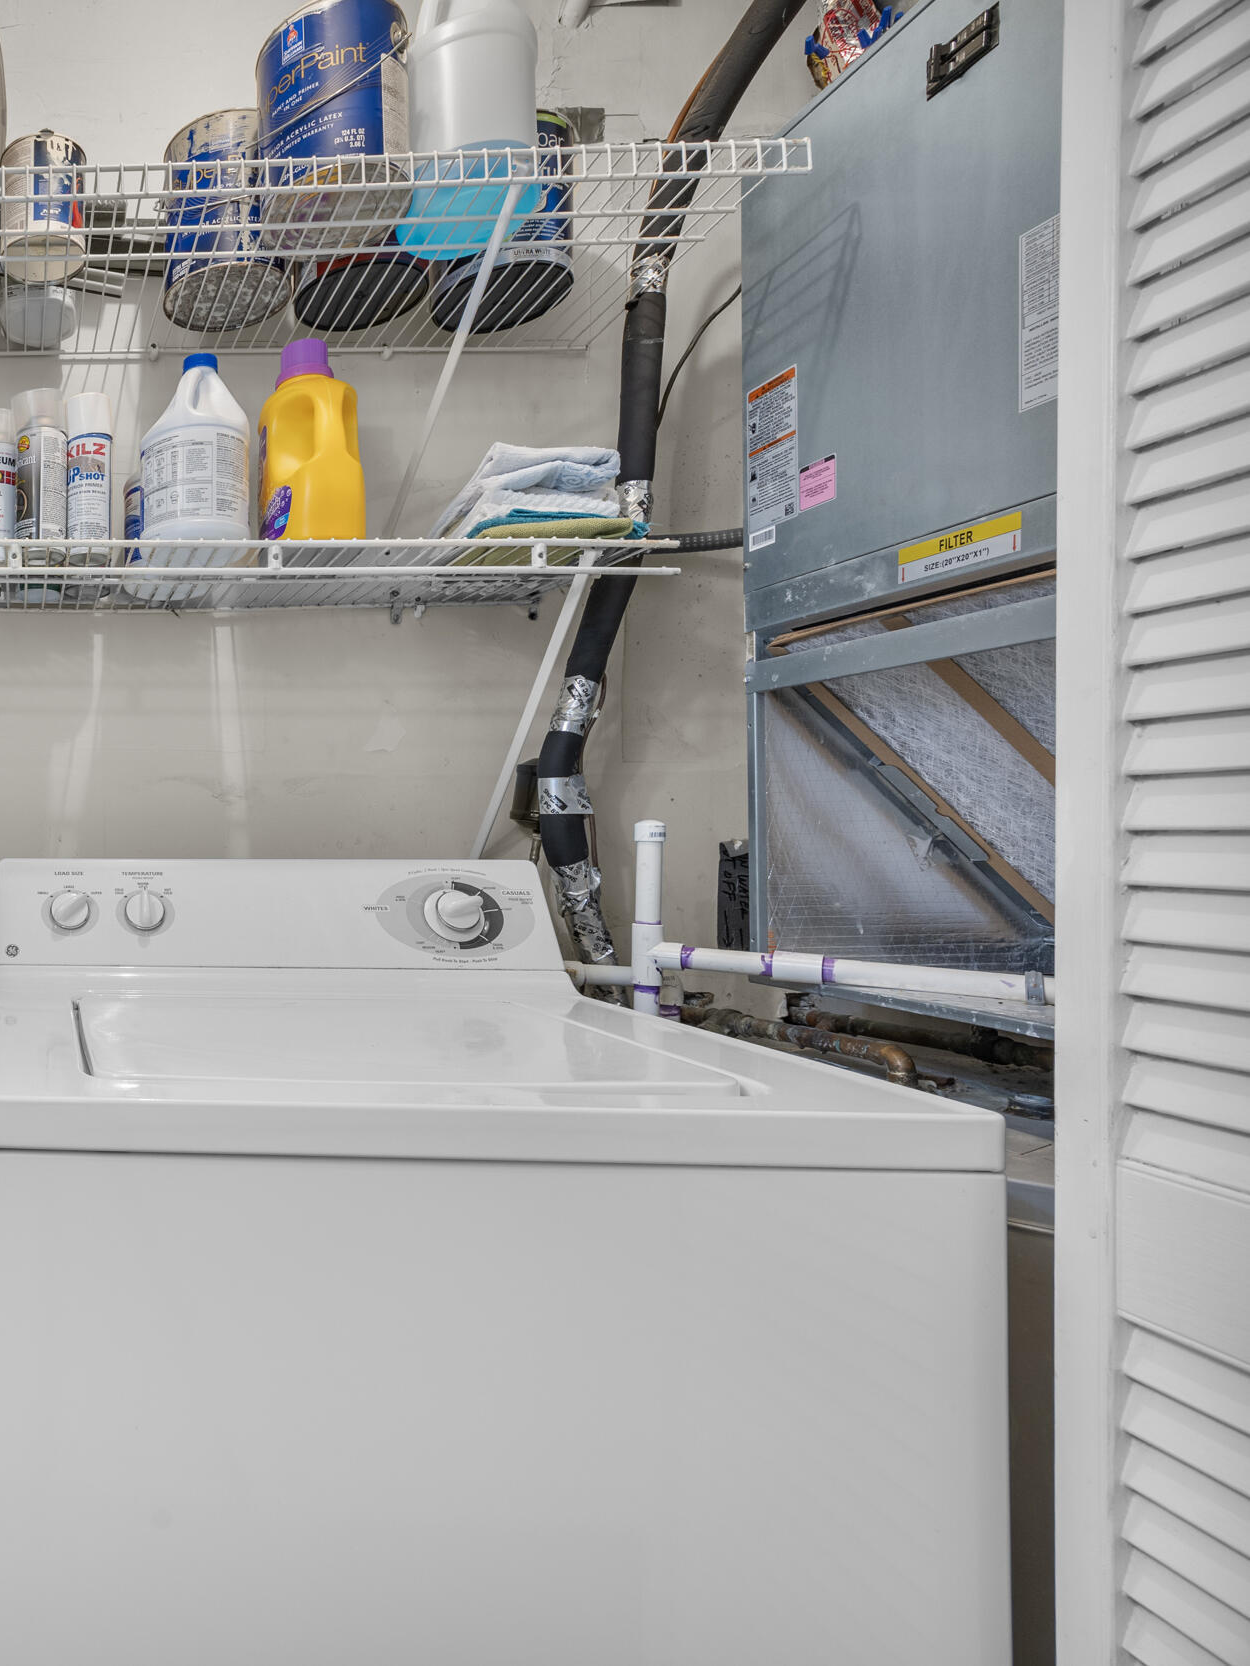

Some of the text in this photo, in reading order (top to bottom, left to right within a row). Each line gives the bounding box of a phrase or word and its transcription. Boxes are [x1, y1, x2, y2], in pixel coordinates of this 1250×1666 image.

[285, 93, 297, 105] AND
[298, 82, 319, 96] PRIMER
[291, 95, 303, 107] ONE
[286, 119, 316, 142] ACRYLIC
[319, 112, 343, 123] LATEX
[302, 123, 334, 139] WARRANTY
[67, 442, 106, 459] KILZ
[938, 530, 974, 552] FILTER
